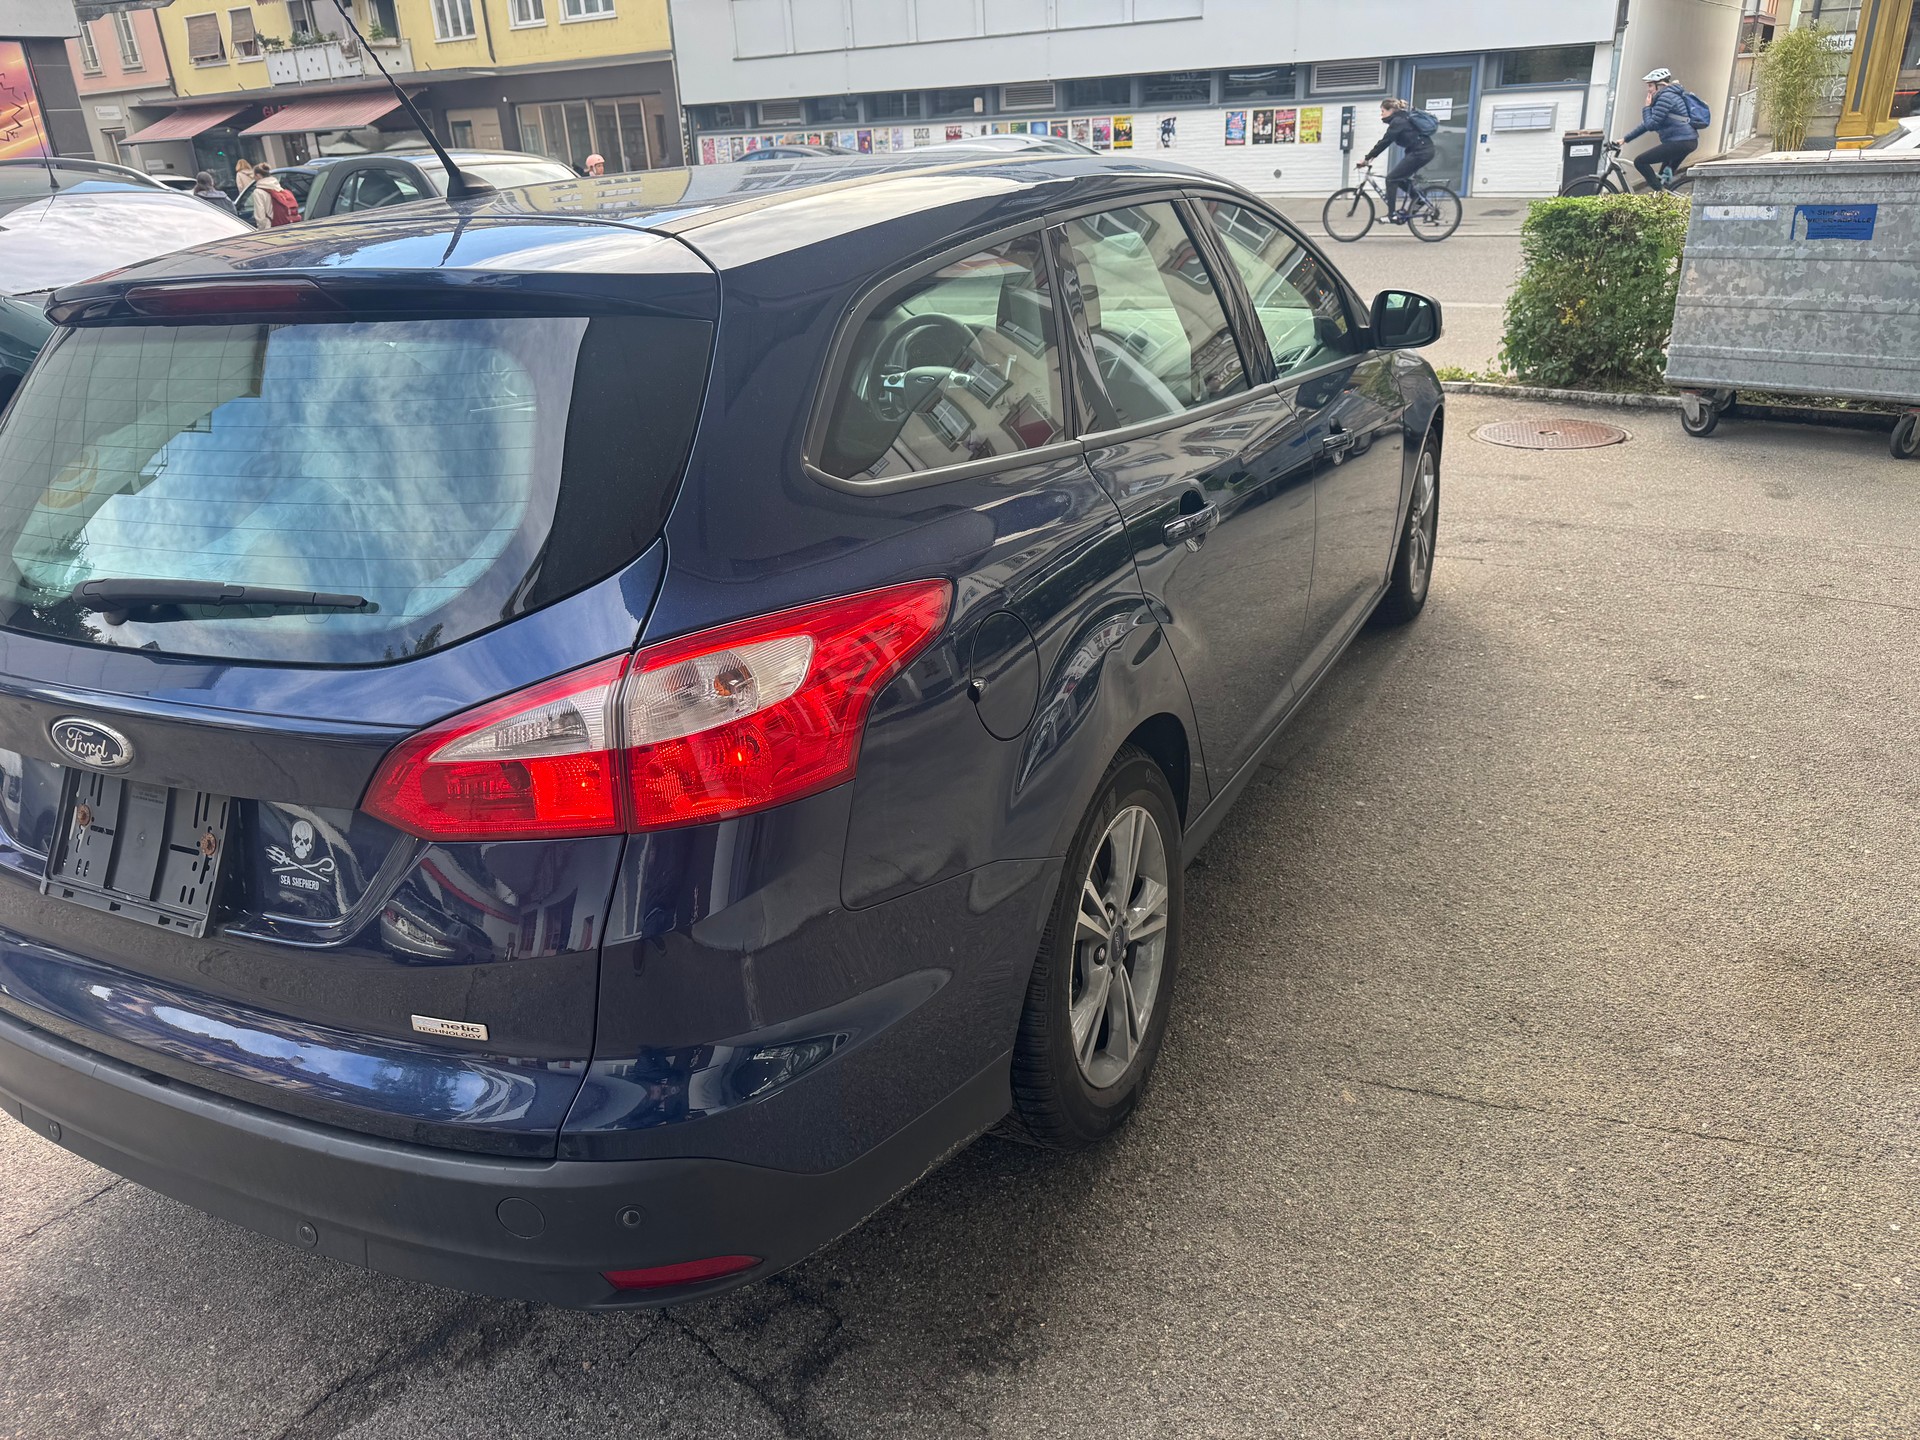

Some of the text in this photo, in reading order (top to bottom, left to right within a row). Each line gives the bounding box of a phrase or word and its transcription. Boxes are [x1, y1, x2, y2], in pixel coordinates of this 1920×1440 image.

[66, 727, 108, 758] Ford
[280, 874, 320, 891] SEA SHEPHERD
[417, 1025, 482, 1039] TECHNOLOGY
